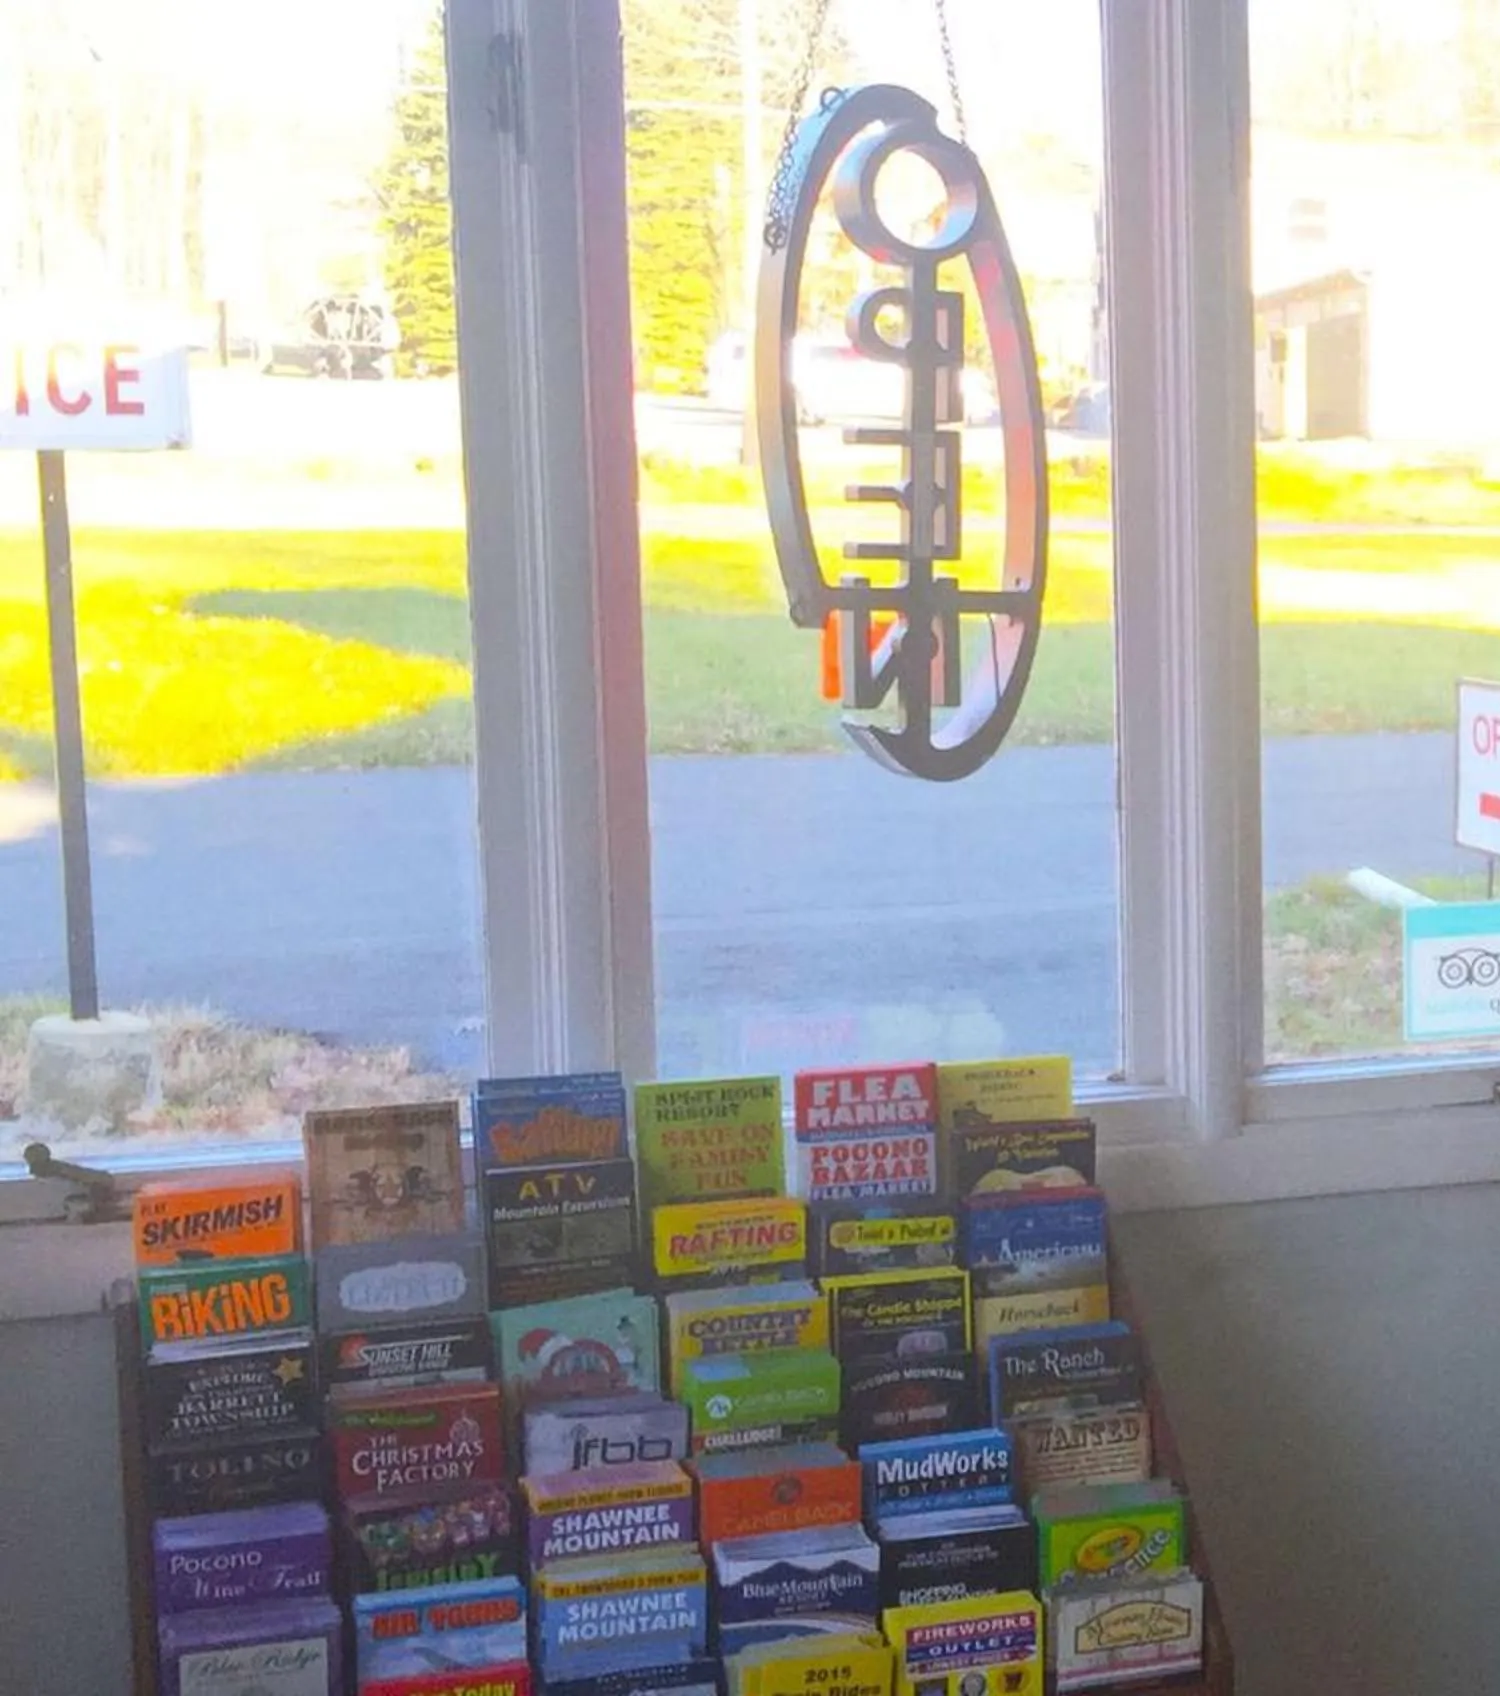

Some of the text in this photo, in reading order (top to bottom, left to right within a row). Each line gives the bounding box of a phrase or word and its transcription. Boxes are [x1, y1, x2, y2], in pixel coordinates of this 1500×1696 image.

[813, 1074, 922, 1106] FLEA
[807, 1100, 929, 1128] MARKET
[811, 1138, 928, 1164] POCONO
[519, 1173, 596, 1200] ATV
[812, 1159, 928, 1186] BAZAAR
[142, 1194, 284, 1247] SKIRMISH
[669, 1221, 798, 1261] RAFTING
[359, 1344, 417, 1366] SUNSET
[1005, 1356, 1037, 1376] The
[1042, 1347, 1104, 1378] Ranch
[904, 1367, 965, 1381] MOUNTAIN
[171, 1402, 295, 1430] TOWNSHIP
[352, 1440, 484, 1475] CHRISTMAS
[877, 1446, 1008, 1485] MudWorks
[376, 1460, 475, 1494] FACTORY
[552, 1504, 670, 1535] SHAWNEE
[543, 1523, 680, 1557] MOUNTAIN
[170, 1551, 262, 1575] Pocono
[567, 1592, 687, 1623] SHAWNEE
[558, 1611, 697, 1645] MOUNTAIN
[912, 1614, 1032, 1643] FIREWORKS
[928, 1635, 1013, 1657] OUTLET
[804, 1666, 852, 1684] 2015
